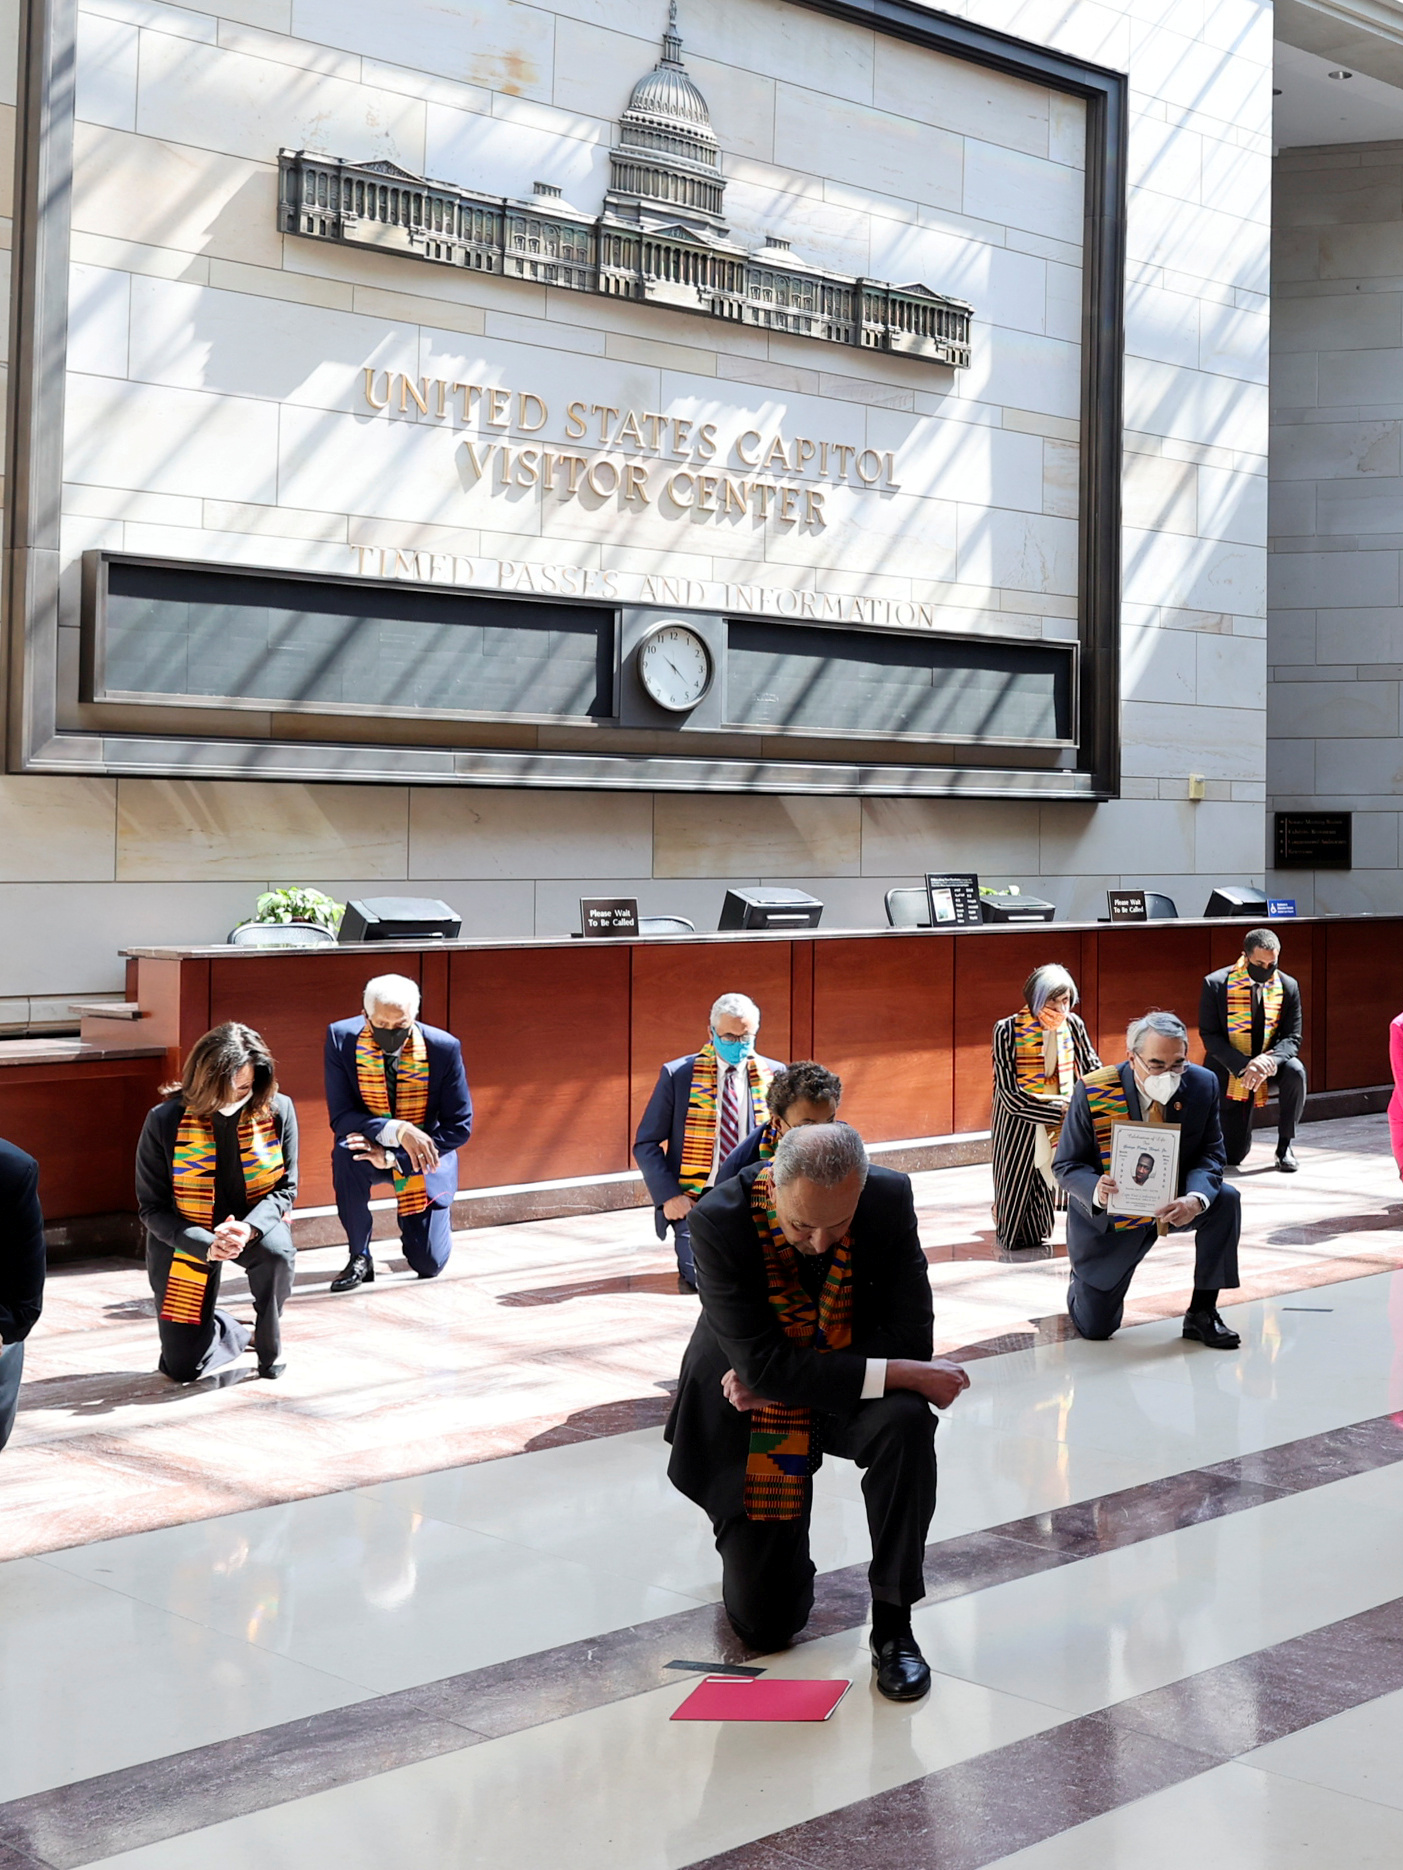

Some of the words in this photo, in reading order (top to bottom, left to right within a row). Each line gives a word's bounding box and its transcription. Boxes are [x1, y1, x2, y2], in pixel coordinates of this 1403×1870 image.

[362, 367, 549, 432] UNITED
[565, 401, 718, 460] STATES
[735, 429, 903, 488] CAPITOL
[462, 441, 652, 504] VISITOR
[667, 471, 827, 527] CENTER
[350, 544, 475, 584] TIMED
[497, 559, 620, 599] PASSES
[638, 574, 706, 604] AND
[723, 582, 936, 628] INFORMATION
[588, 919, 598, 927] To
[612, 918, 635, 926] Called
[590, 909, 612, 917] Please
[614, 909, 631, 917] Wait
